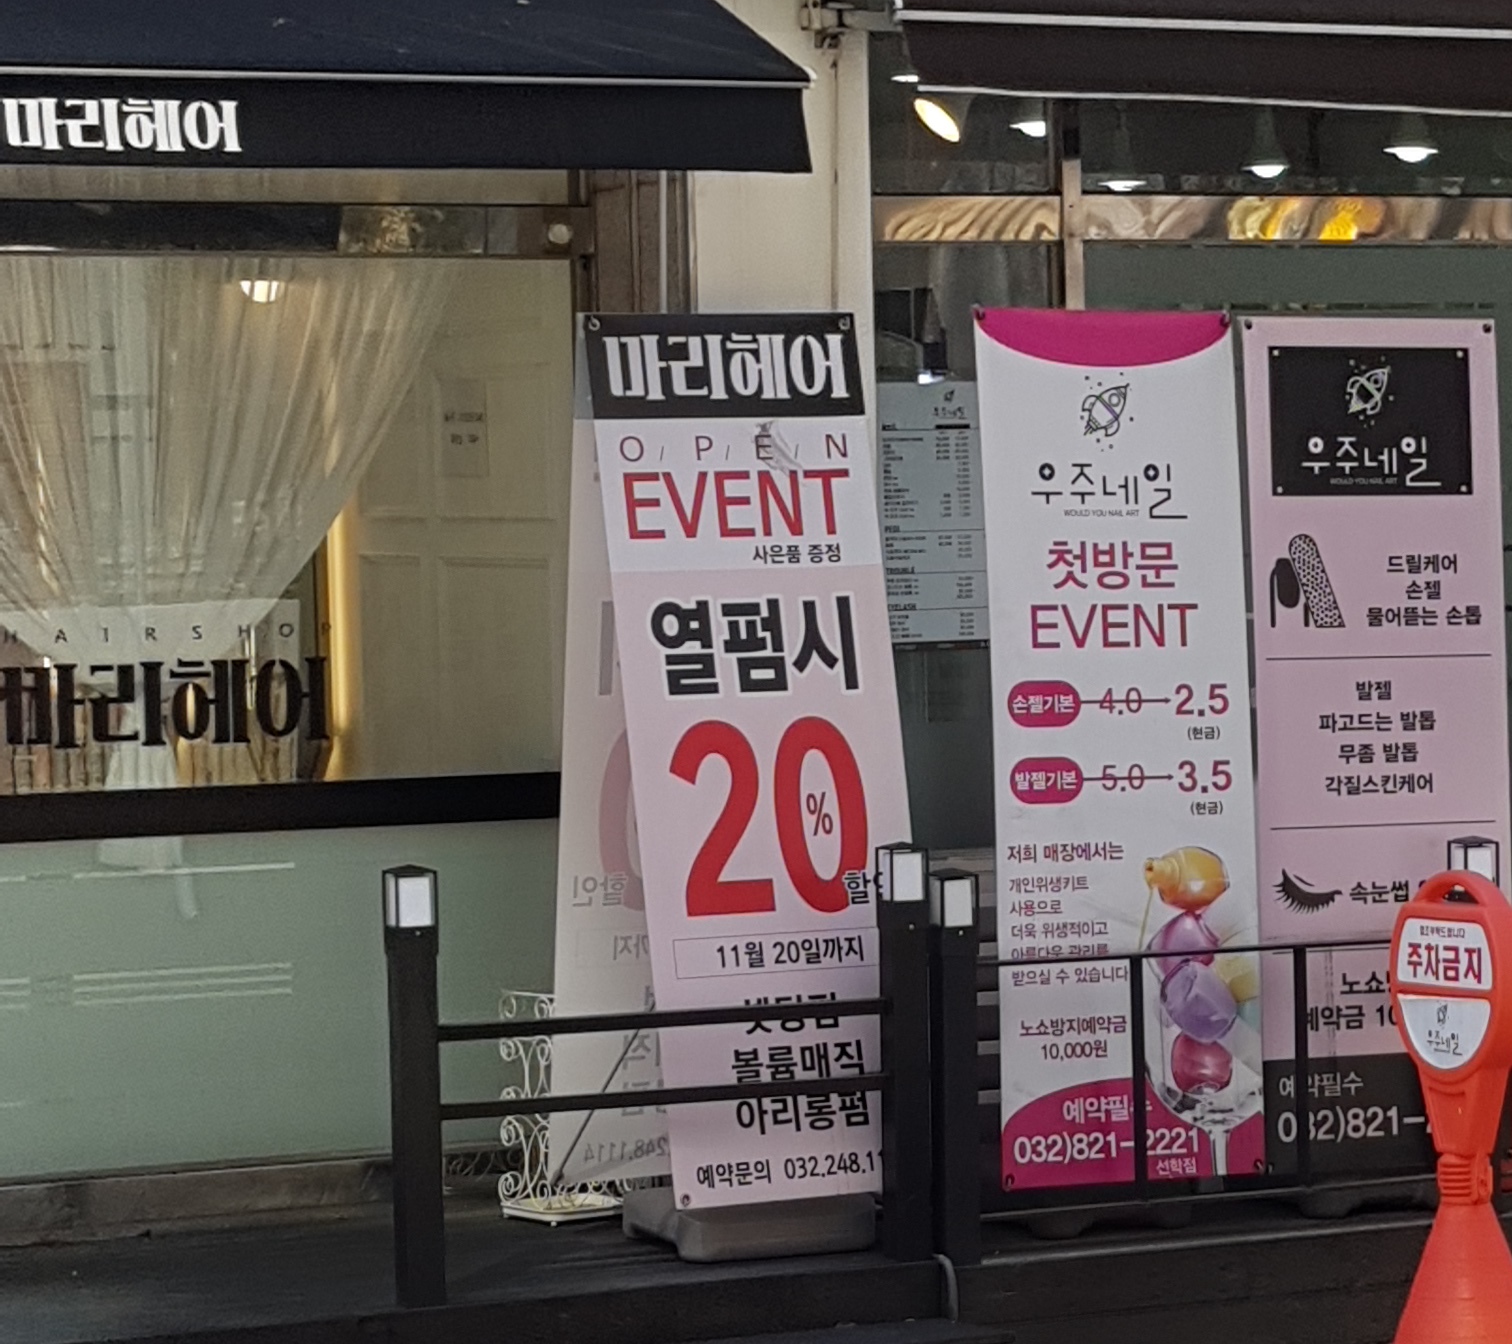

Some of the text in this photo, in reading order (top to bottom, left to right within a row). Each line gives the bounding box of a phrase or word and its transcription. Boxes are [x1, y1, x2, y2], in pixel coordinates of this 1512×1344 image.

[2, 97, 243, 152] 마리헤어
[603, 332, 851, 401] 마리헤어
[1301, 436, 1441, 487] 우주네일
[1031, 462, 1188, 519] 우주네일
[623, 468, 850, 539] EVENT
[1063, 509, 1140, 517] WOULD YOU NAIL ART
[752, 542, 842, 565] 사은품 증정
[1047, 540, 1179, 589] 첫방문
[1387, 553, 1458, 574] 드릴케어
[1405, 580, 1441, 601] 손젤
[1030, 603, 1198, 649] EVENT
[1366, 605, 1482, 627] 물어뜯는 손톱
[650, 595, 859, 695] 열펌시
[1012, 683, 1229, 717] 손젤기본 4.0 2.5
[1356, 680, 1392, 701] 발젤
[1187, 725, 1221, 741] (현금)
[1319, 710, 1436, 733] 파고드는 발톱
[1338, 742, 1418, 764] 무좀 발톱
[1014, 759, 1232, 794] 발젤기본 5.0 3.5
[1325, 773, 1434, 796] 각질스킨케어
[1190, 800, 1223, 816] (현금)
[1007, 841, 1124, 864] 저희 매장에서는
[1009, 874, 1089, 894] 개인위생키트
[1349, 879, 1409, 904] 속눈썹
[1009, 899, 1063, 918] 사용으로
[1011, 920, 1109, 940] 더욱 위생적이고
[716, 934, 864, 969] 11월 20일까지
[1407, 942, 1482, 984] 주차금지
[1012, 966, 1128, 986] 받으실 수 있습니다
[1019, 1015, 1127, 1038] 노쇼방지예약금
[1041, 1039, 1108, 1061] 10,000원
[1427, 1029, 1463, 1056] 우주네일
[732, 1039, 865, 1084] 볼륨매직
[736, 1091, 870, 1135] 아리롱펌
[696, 1159, 771, 1189] 예약문의
[1156, 1157, 1197, 1175] 선학점
